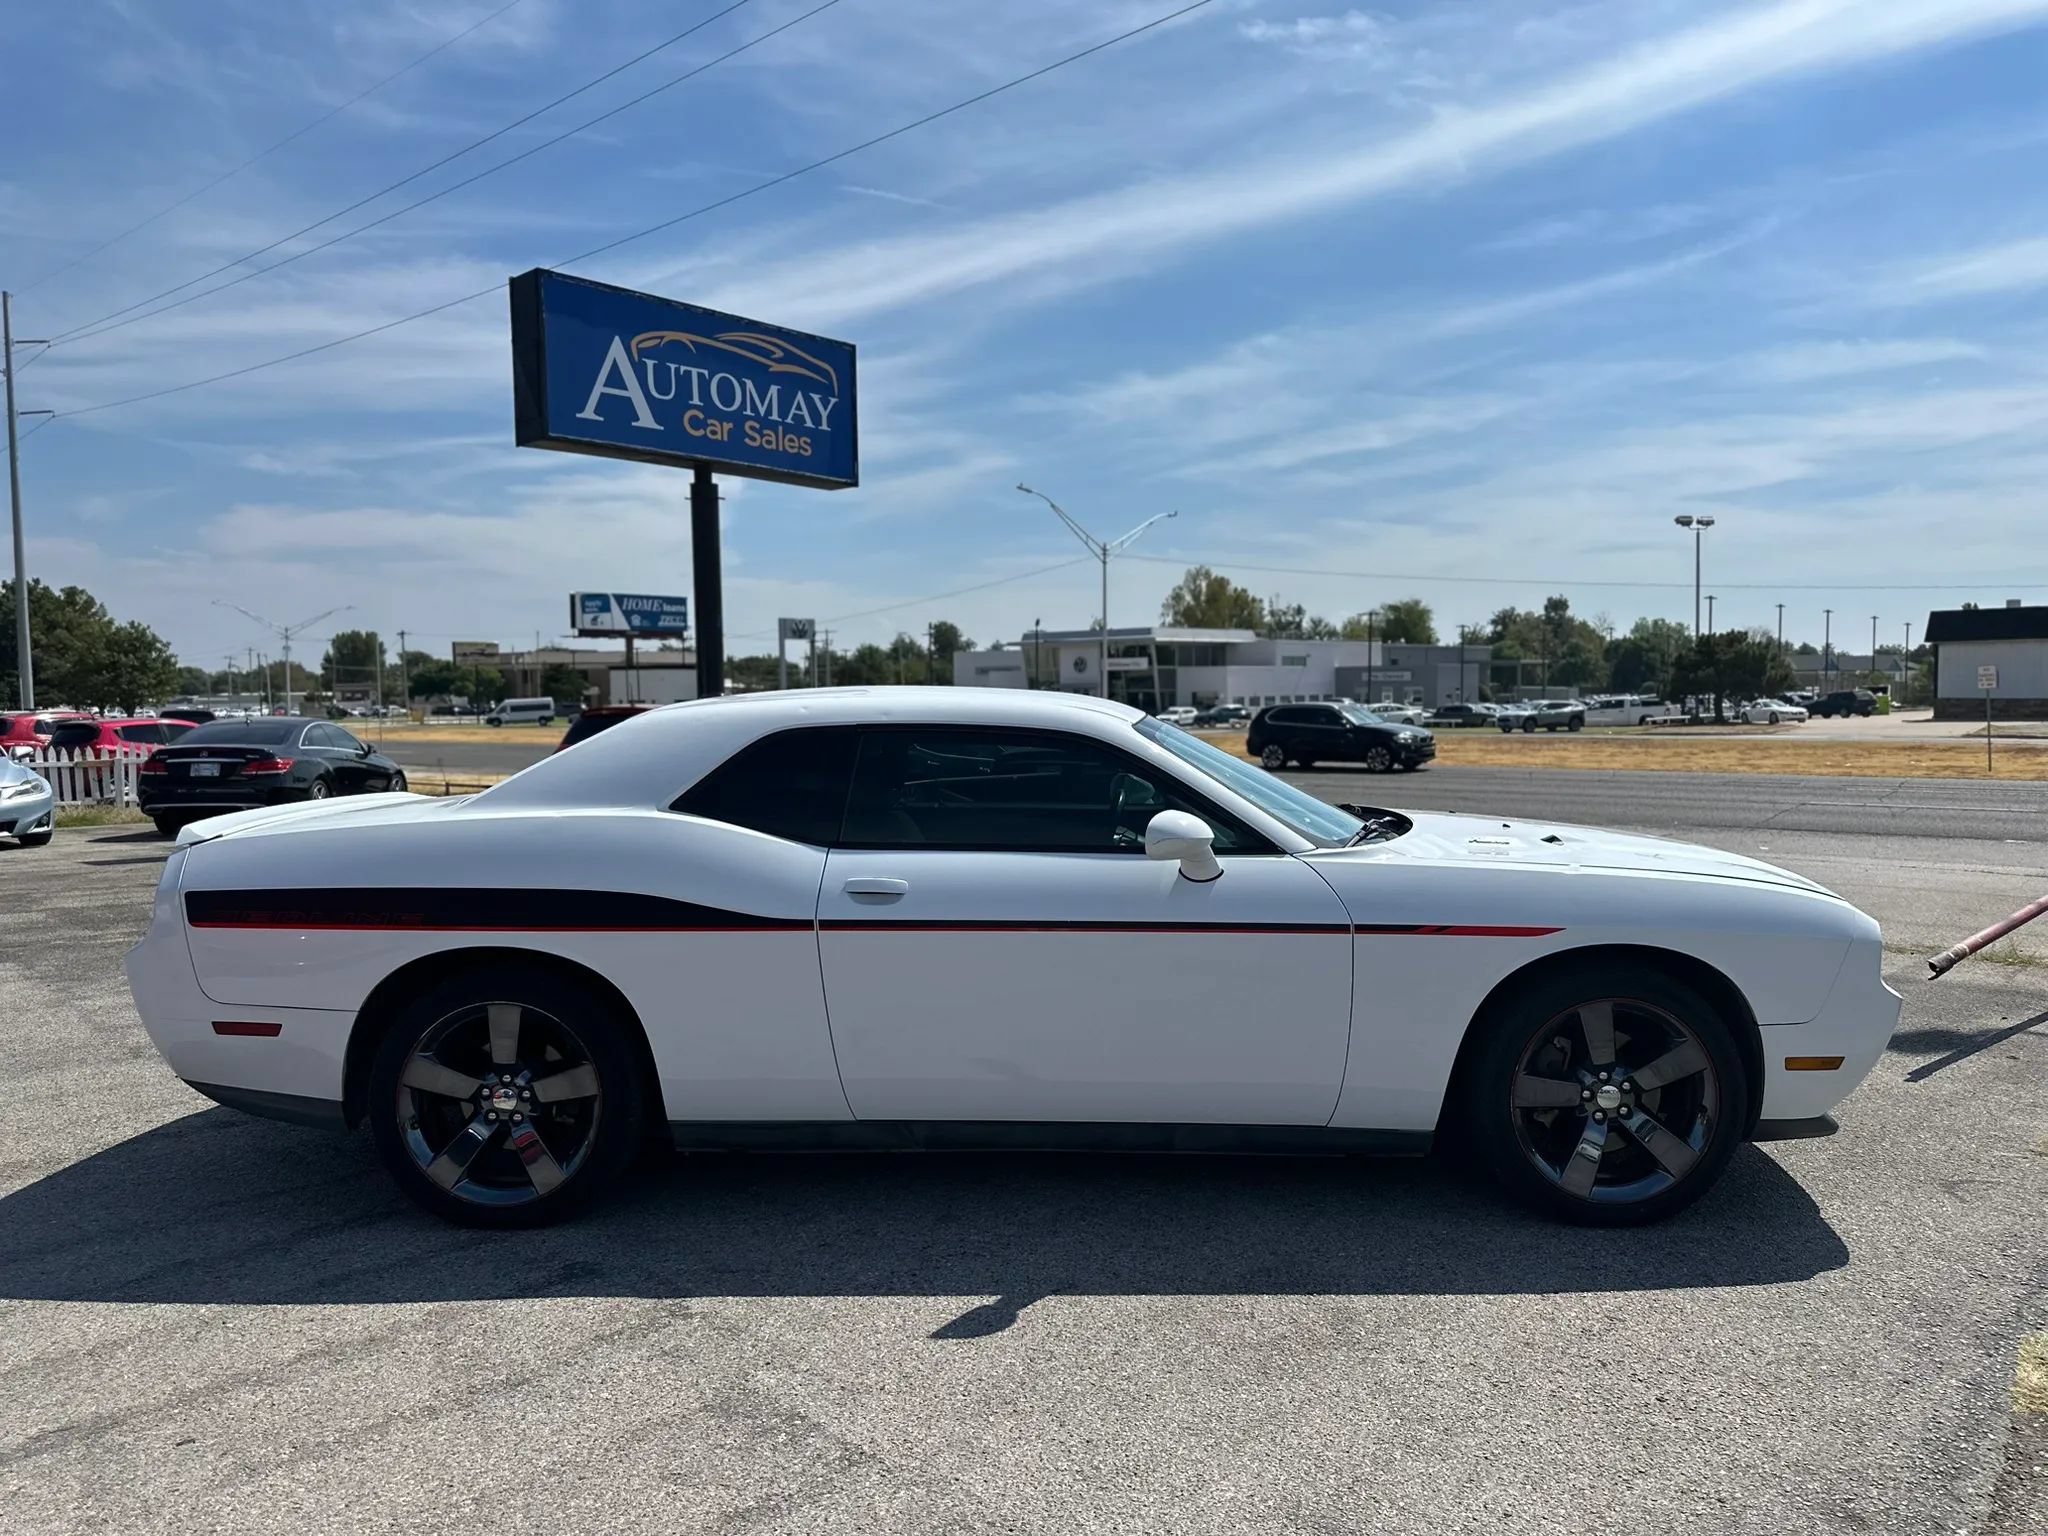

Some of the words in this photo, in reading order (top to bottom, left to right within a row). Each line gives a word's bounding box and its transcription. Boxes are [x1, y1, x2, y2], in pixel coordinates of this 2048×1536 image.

[575, 335, 840, 432] AUTOMAY
[683, 409, 734, 442] Car
[744, 421, 813, 457] Sales
[622, 597, 663, 612] HOME
